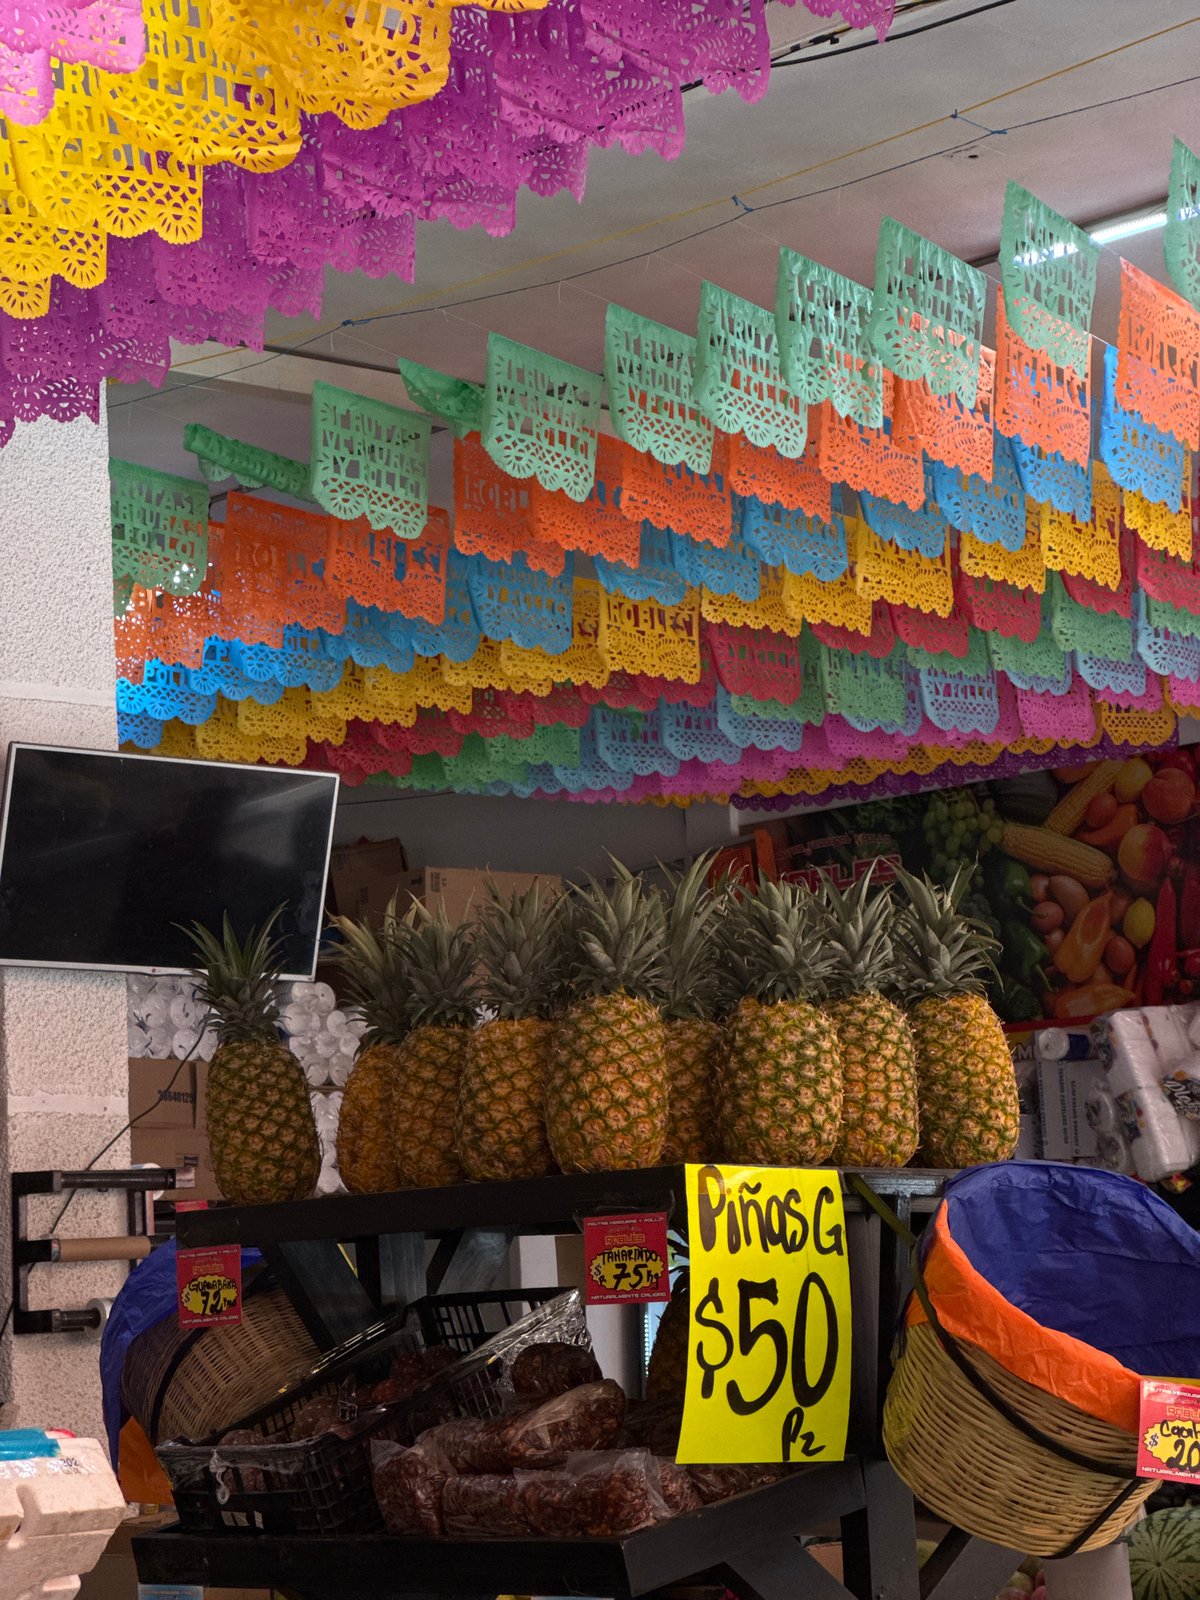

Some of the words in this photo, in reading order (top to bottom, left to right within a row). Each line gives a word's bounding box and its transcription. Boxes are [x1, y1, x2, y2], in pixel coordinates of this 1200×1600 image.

[608, 600, 691, 637] ROBLES
[697, 1165, 809, 1254] Piñas
[613, 1262, 648, 1290] 75
[695, 1271, 839, 1416] $50
